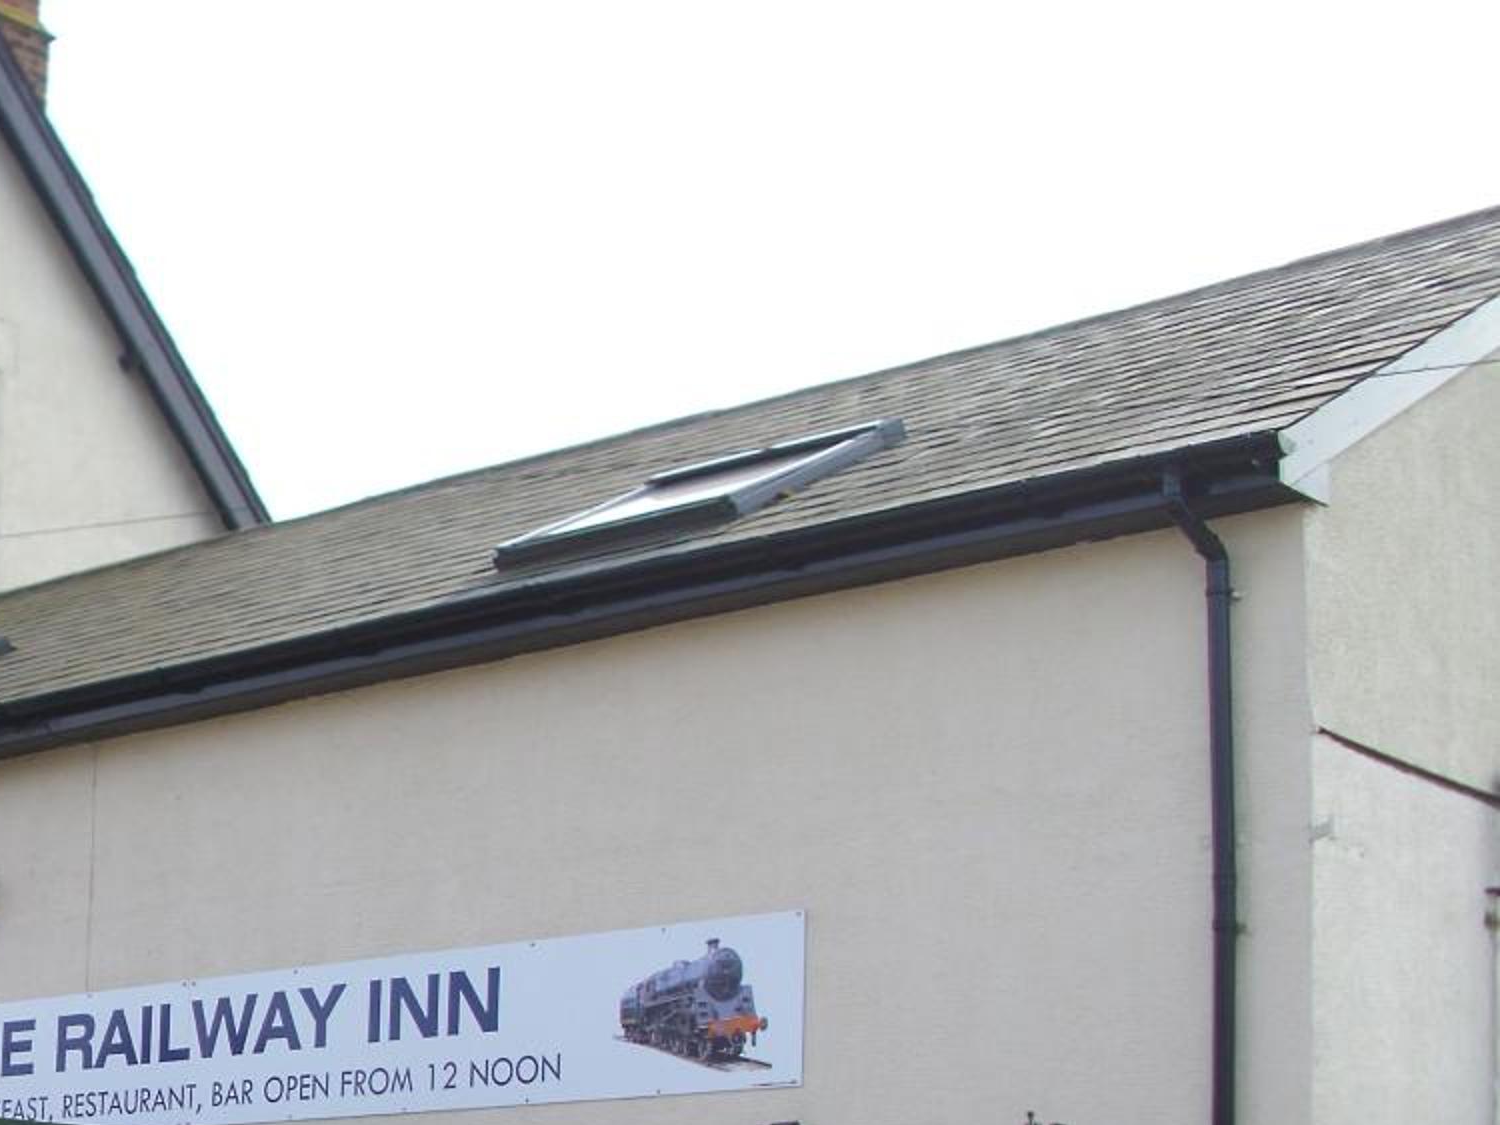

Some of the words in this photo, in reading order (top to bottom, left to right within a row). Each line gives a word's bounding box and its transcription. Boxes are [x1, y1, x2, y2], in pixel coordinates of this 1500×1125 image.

[55, 983, 347, 1073] RAILWAY
[367, 966, 501, 1044] INN
[62, 1083, 201, 1119] RESTAURANT,
[211, 1080, 253, 1107] BAR
[263, 1072, 329, 1103] OPEN
[341, 1066, 413, 1097] FROM
[427, 1062, 458, 1091] 12
[470, 1053, 562, 1088] NOON
